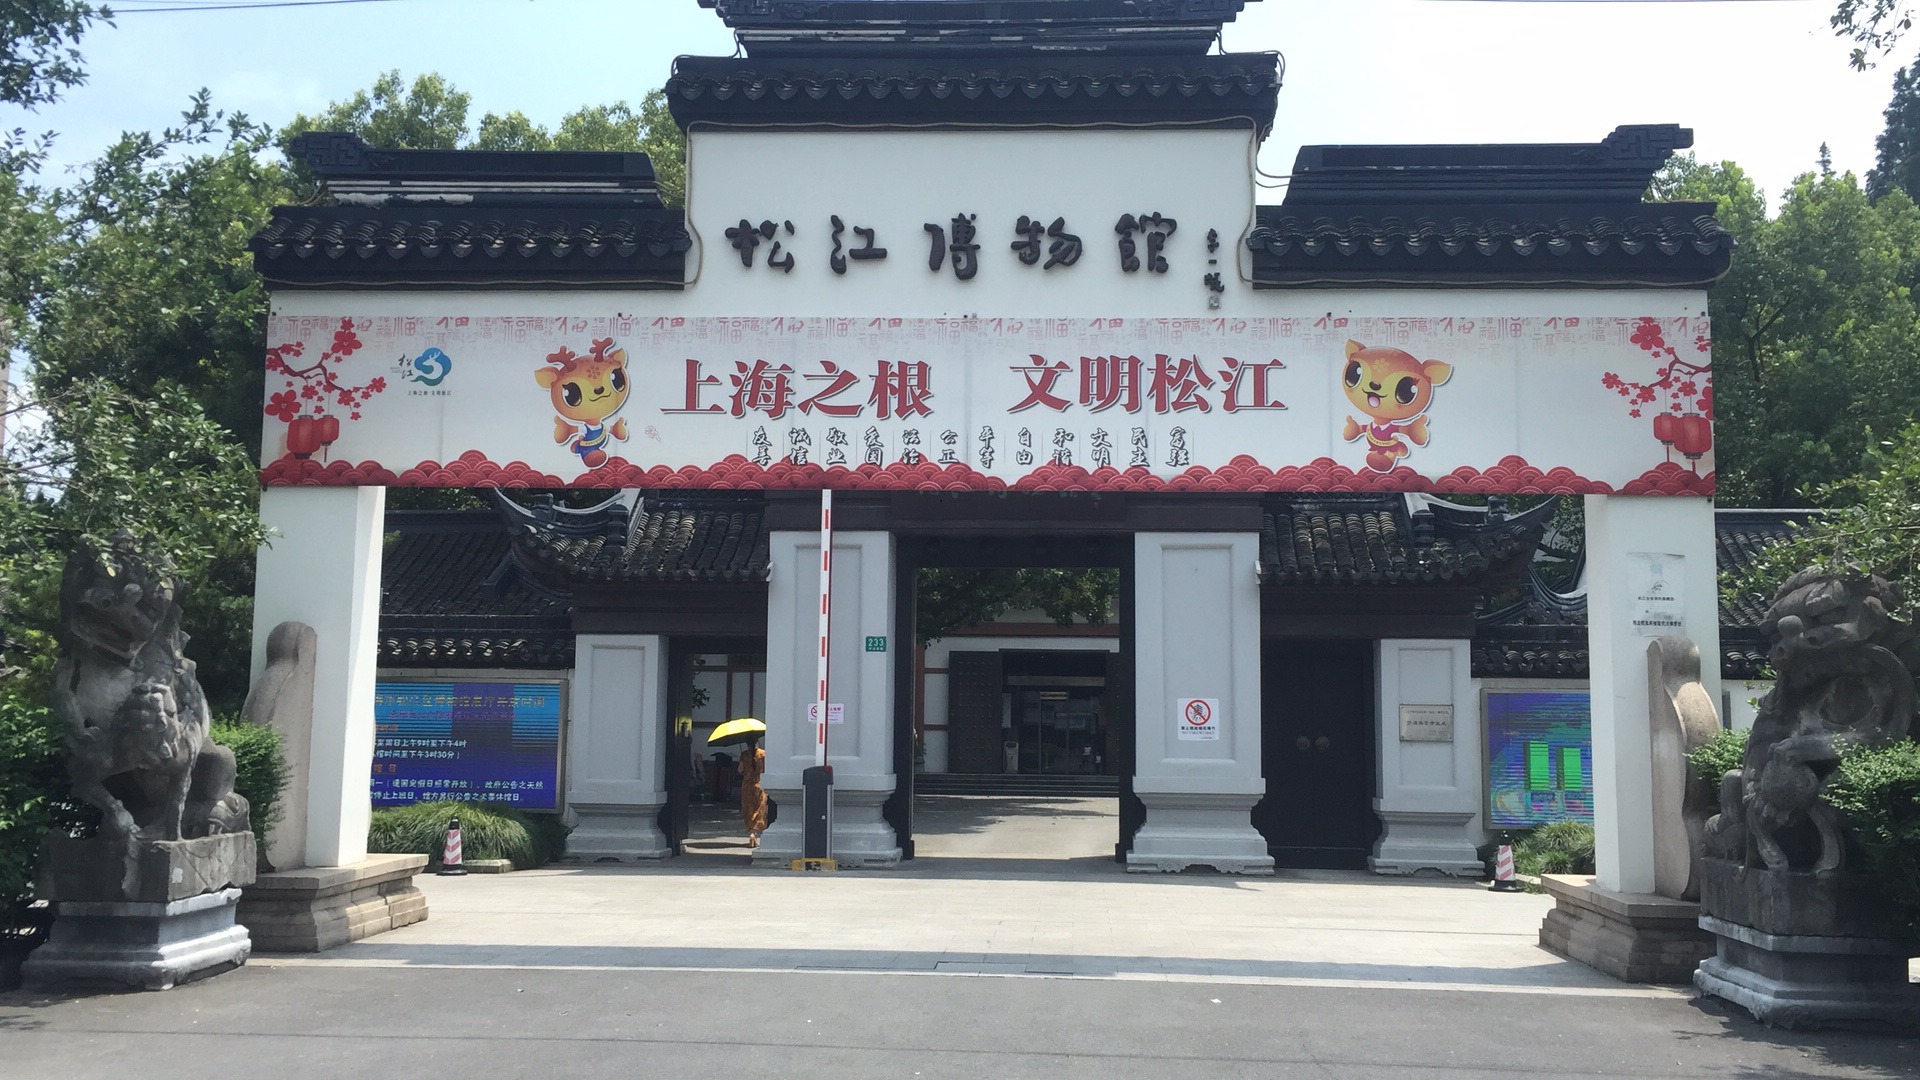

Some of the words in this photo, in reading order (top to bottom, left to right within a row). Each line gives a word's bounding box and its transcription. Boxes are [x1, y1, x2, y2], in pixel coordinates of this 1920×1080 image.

[660, 358, 936, 420] 上海之根
[1006, 353, 1289, 414] 文明松江
[751, 425, 773, 466] 友善
[788, 426, 811, 466] 诚信
[825, 426, 848, 466] 敬业
[901, 427, 921, 466] 法治
[937, 428, 960, 465] 公正
[978, 425, 996, 468] 平等
[1015, 426, 1033, 467] 自由
[1052, 427, 1075, 467] 和谐
[1090, 426, 1113, 469] 文明
[1128, 426, 1151, 468] 民主
[1165, 425, 1190, 467] 富强
[868, 638, 884, 647] 233
